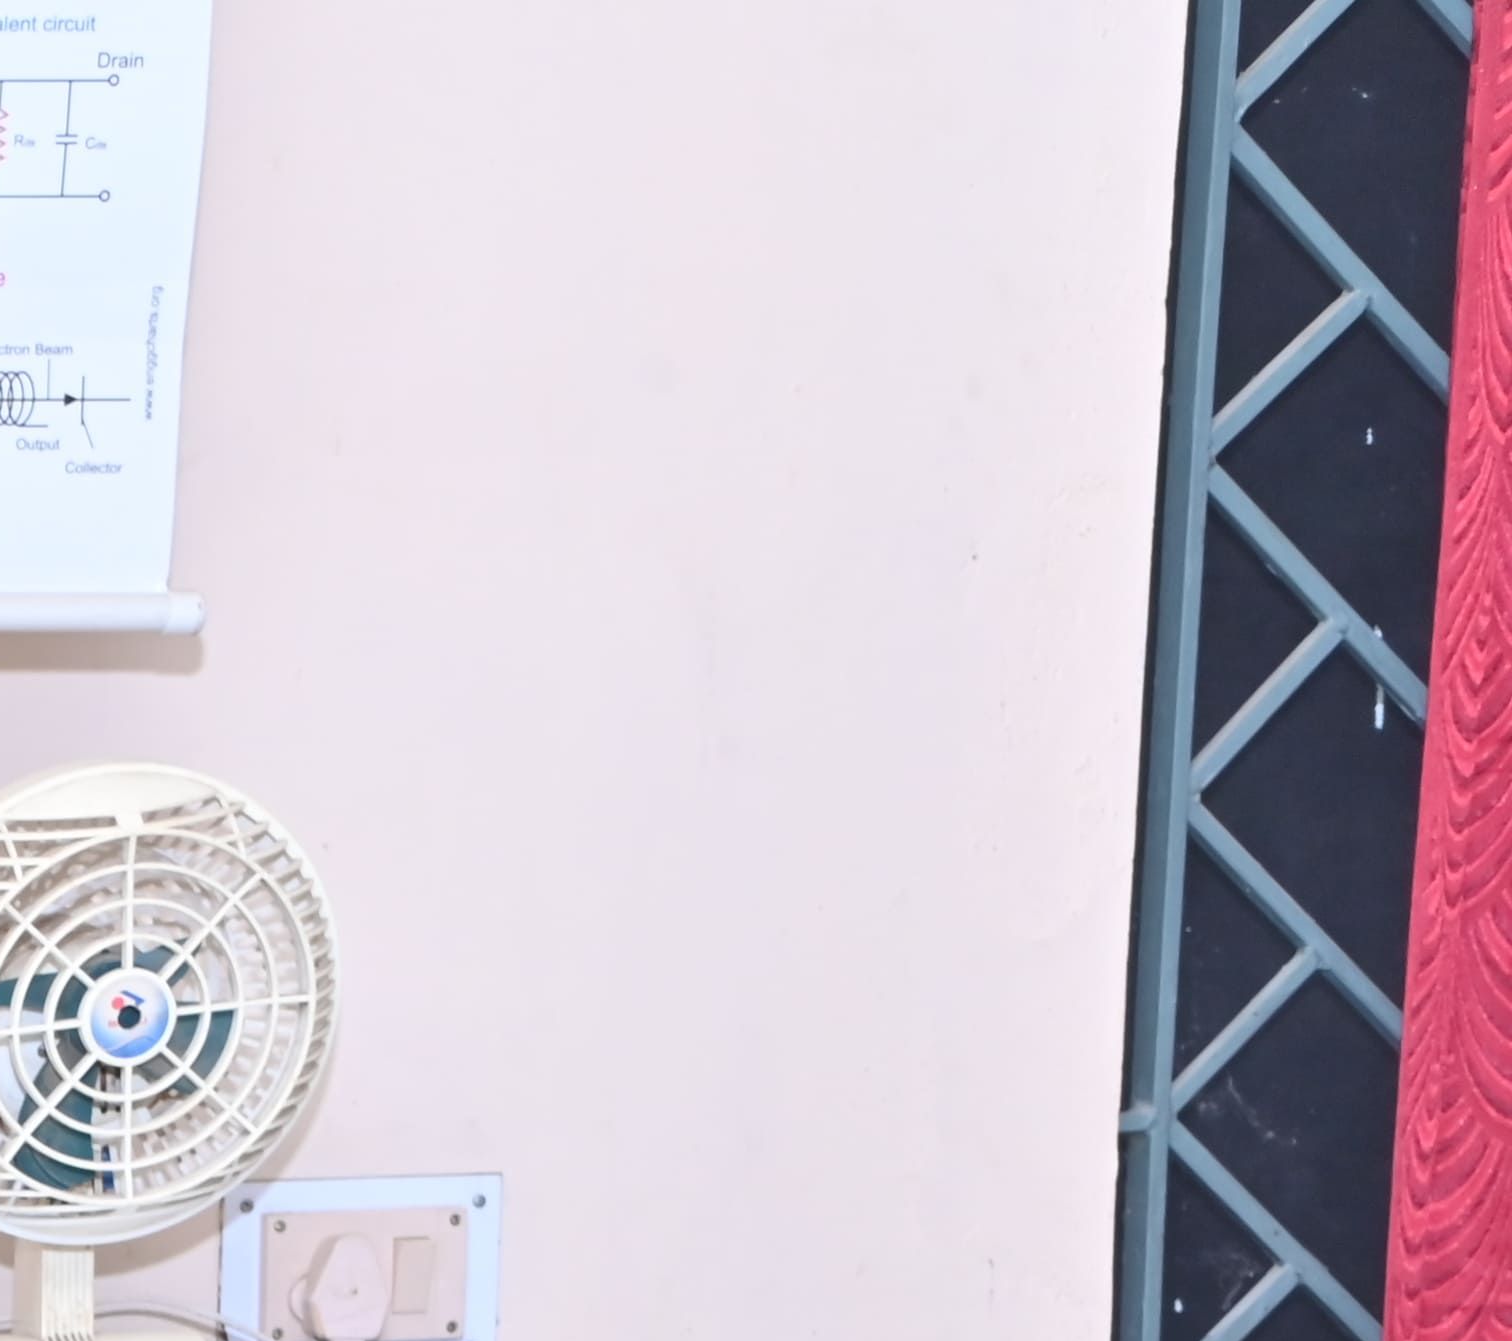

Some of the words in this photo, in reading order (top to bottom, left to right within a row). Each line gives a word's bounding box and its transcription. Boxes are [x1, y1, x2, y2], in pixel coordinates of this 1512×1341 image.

[43, 16, 95, 32] circuit
[97, 52, 144, 69] Drain
[35, 344, 73, 356] Beam
[16, 439, 60, 452] Output
[65, 462, 122, 474] Collector
